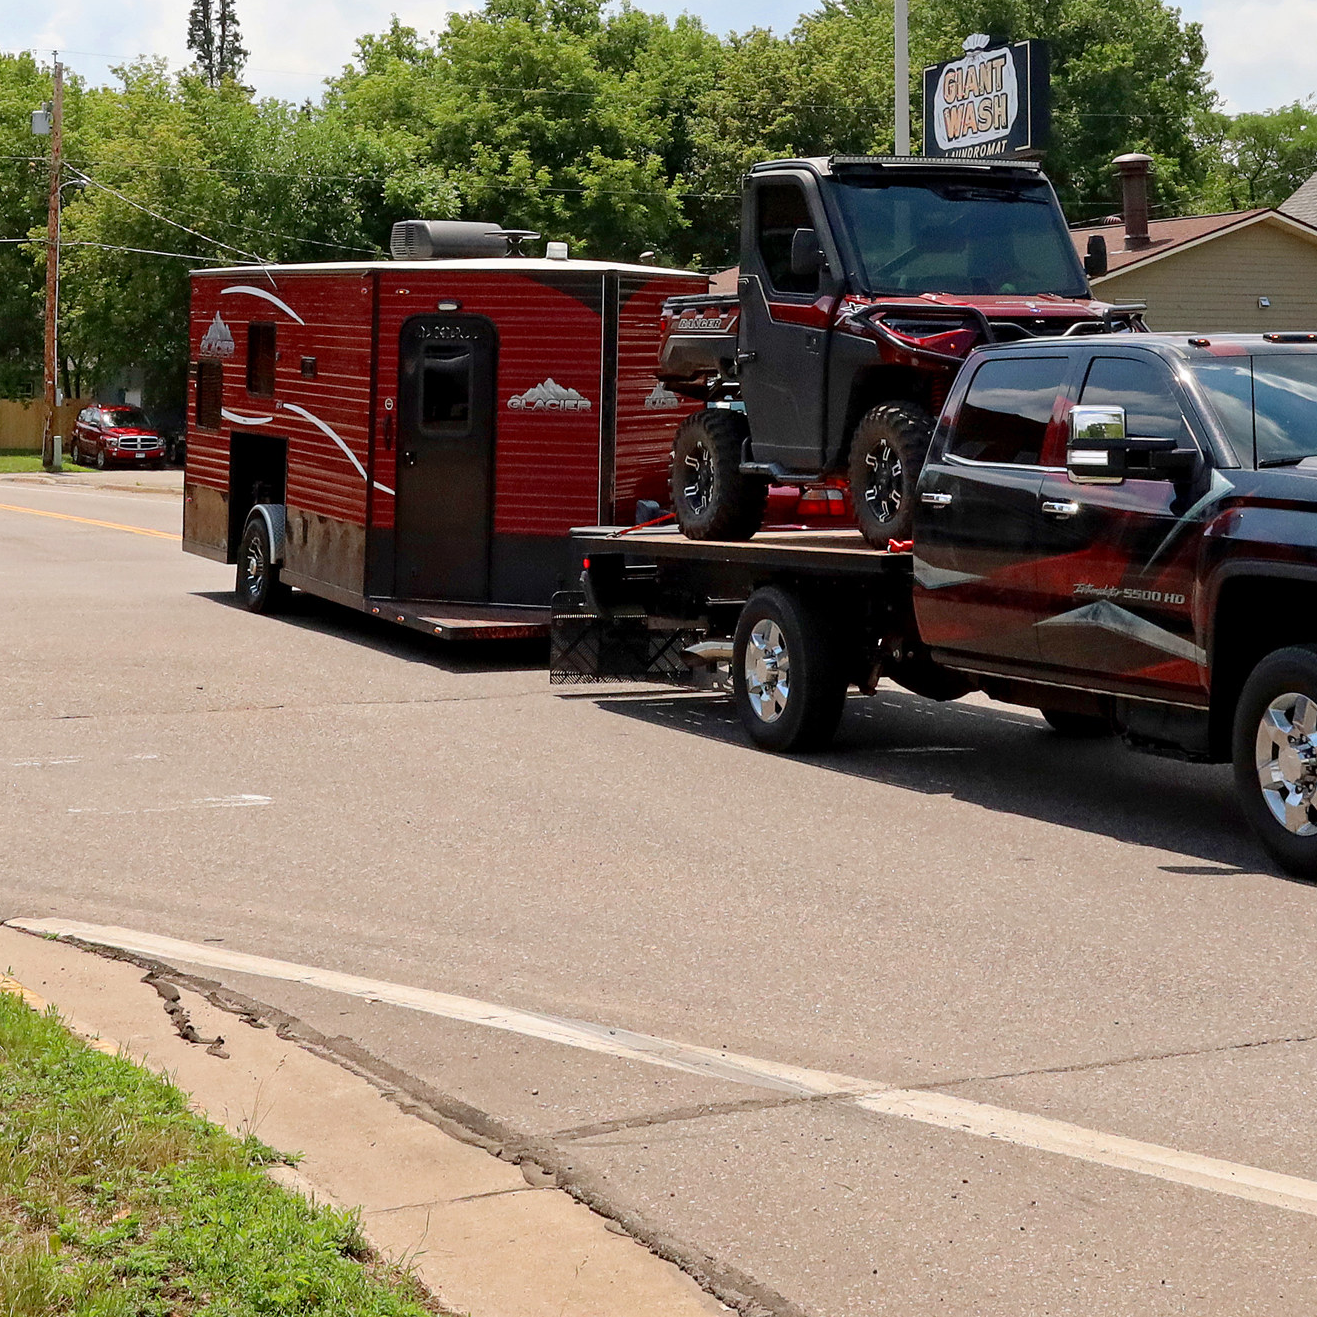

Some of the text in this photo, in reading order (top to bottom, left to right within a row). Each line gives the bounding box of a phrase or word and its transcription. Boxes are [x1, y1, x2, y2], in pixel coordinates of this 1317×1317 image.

[943, 54, 1007, 104] GIANT
[943, 93, 1009, 143] WASH
[678, 318, 722, 330] RANGER
[506, 397, 592, 412] GLACIER
[1164, 593, 1185, 605] HD
